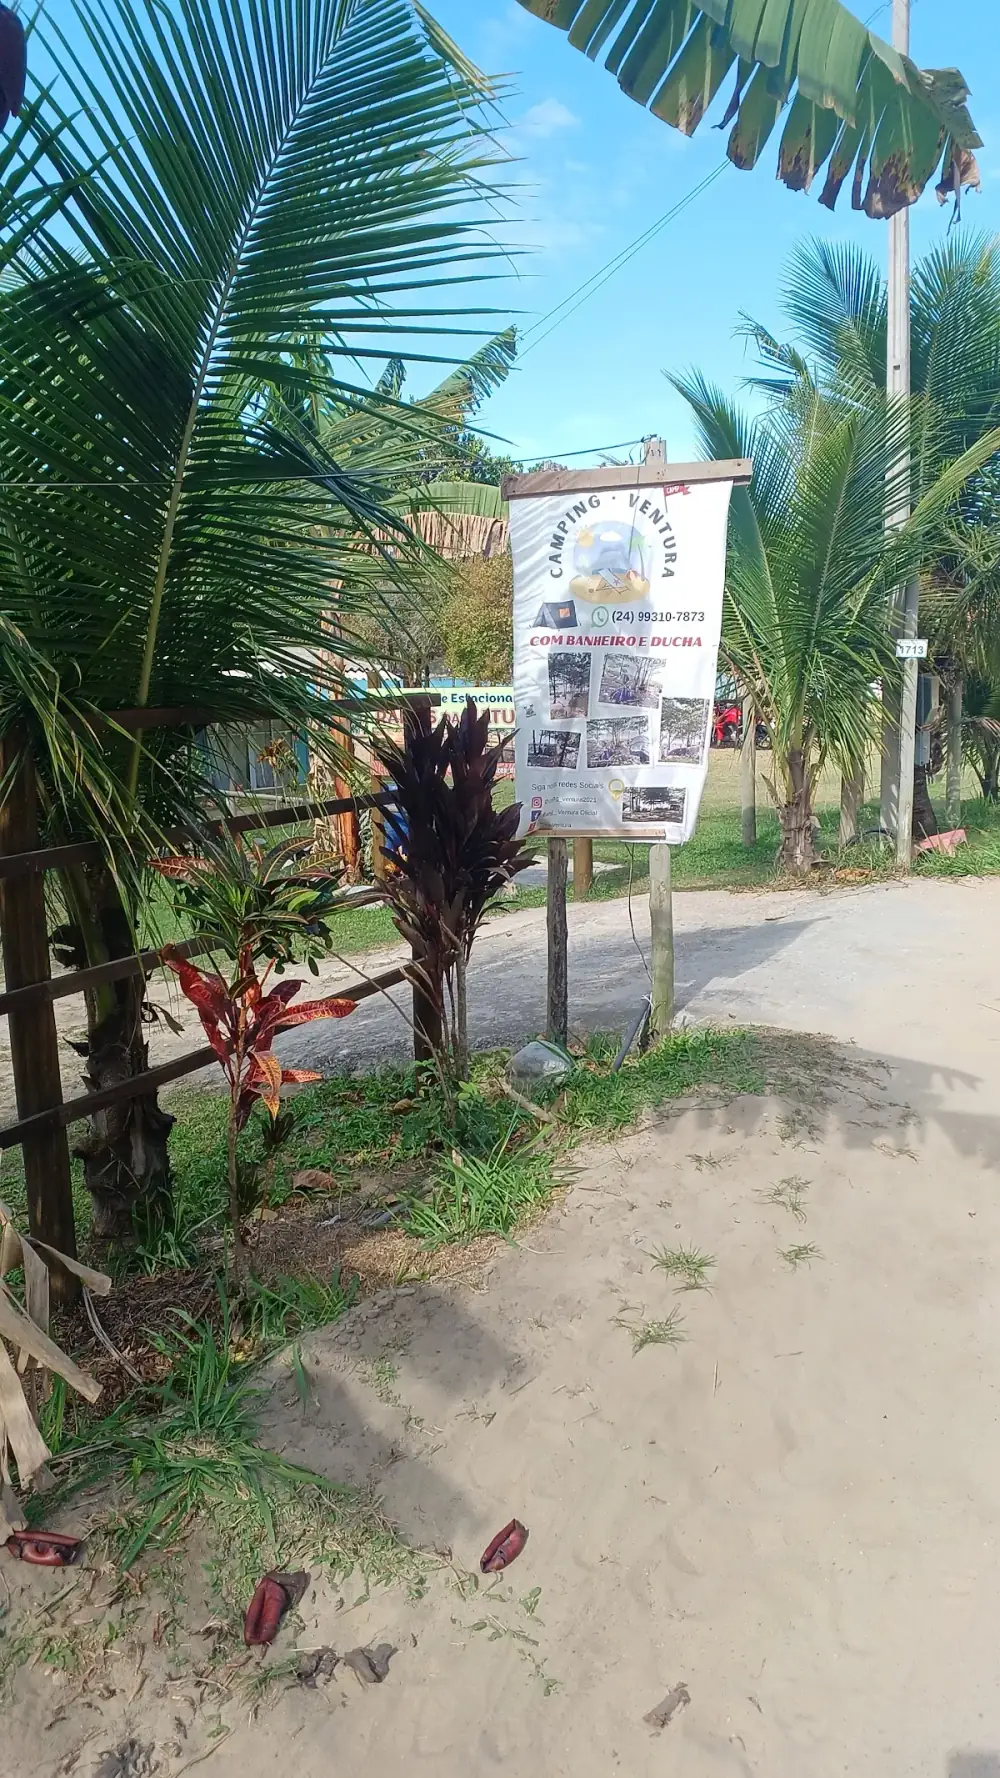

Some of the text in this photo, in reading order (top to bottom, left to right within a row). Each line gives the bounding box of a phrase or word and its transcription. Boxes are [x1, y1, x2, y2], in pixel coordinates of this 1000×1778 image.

[549, 493, 677, 579] CAMPING VENTURA
[612, 610, 705, 624] (24) 99310-7873
[530, 635, 703, 647] COM BANHEIRO E DUCHA
[900, 645, 924, 655] 1713
[558, 781, 578, 789] redes
